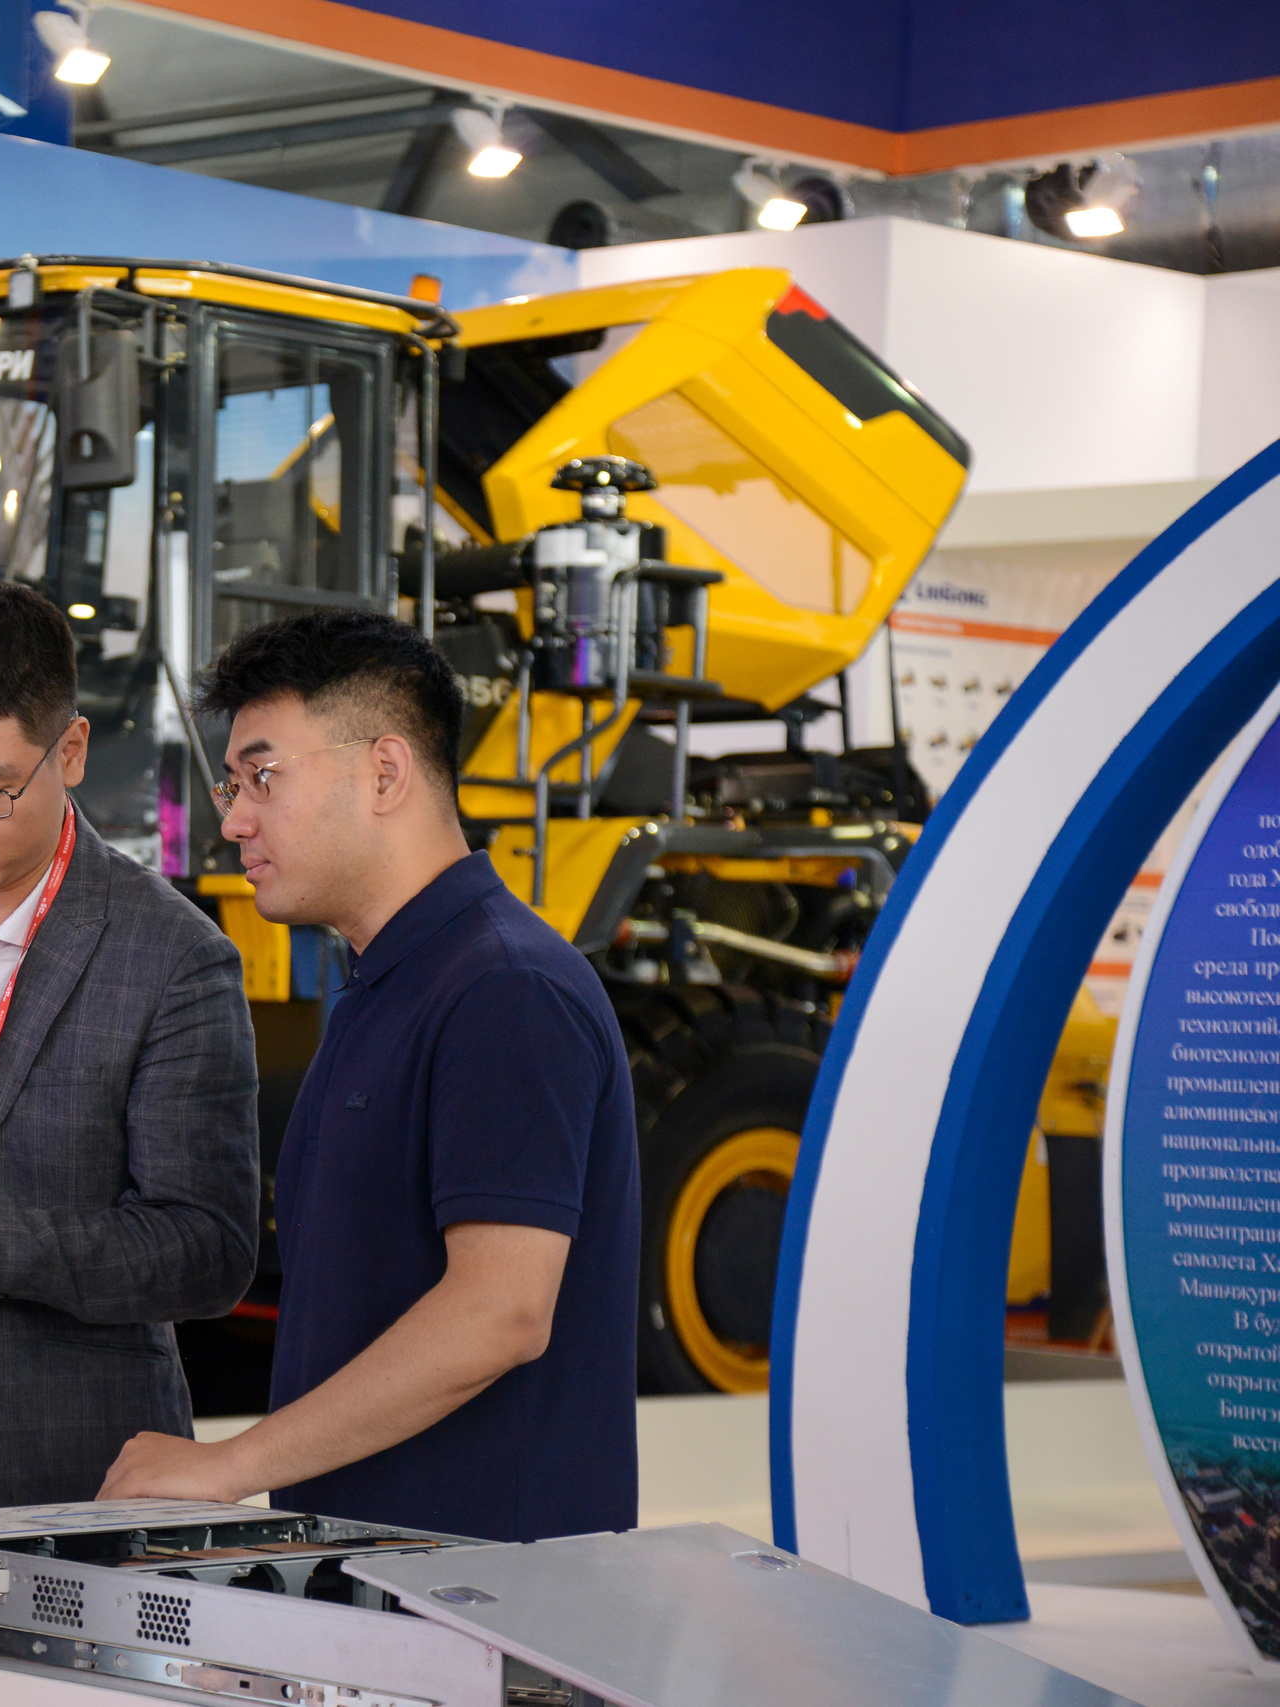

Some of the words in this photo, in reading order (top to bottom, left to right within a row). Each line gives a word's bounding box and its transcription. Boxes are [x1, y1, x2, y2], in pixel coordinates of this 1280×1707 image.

[1228, 873, 1267, 889] года
[1194, 961, 1249, 980] среда
[1173, 1251, 1256, 1272] самолета
[1262, 1252, 1280, 1273] Х
[1235, 1311, 1249, 1330] В
[1220, 1398, 1280, 1422] Бинчэ
